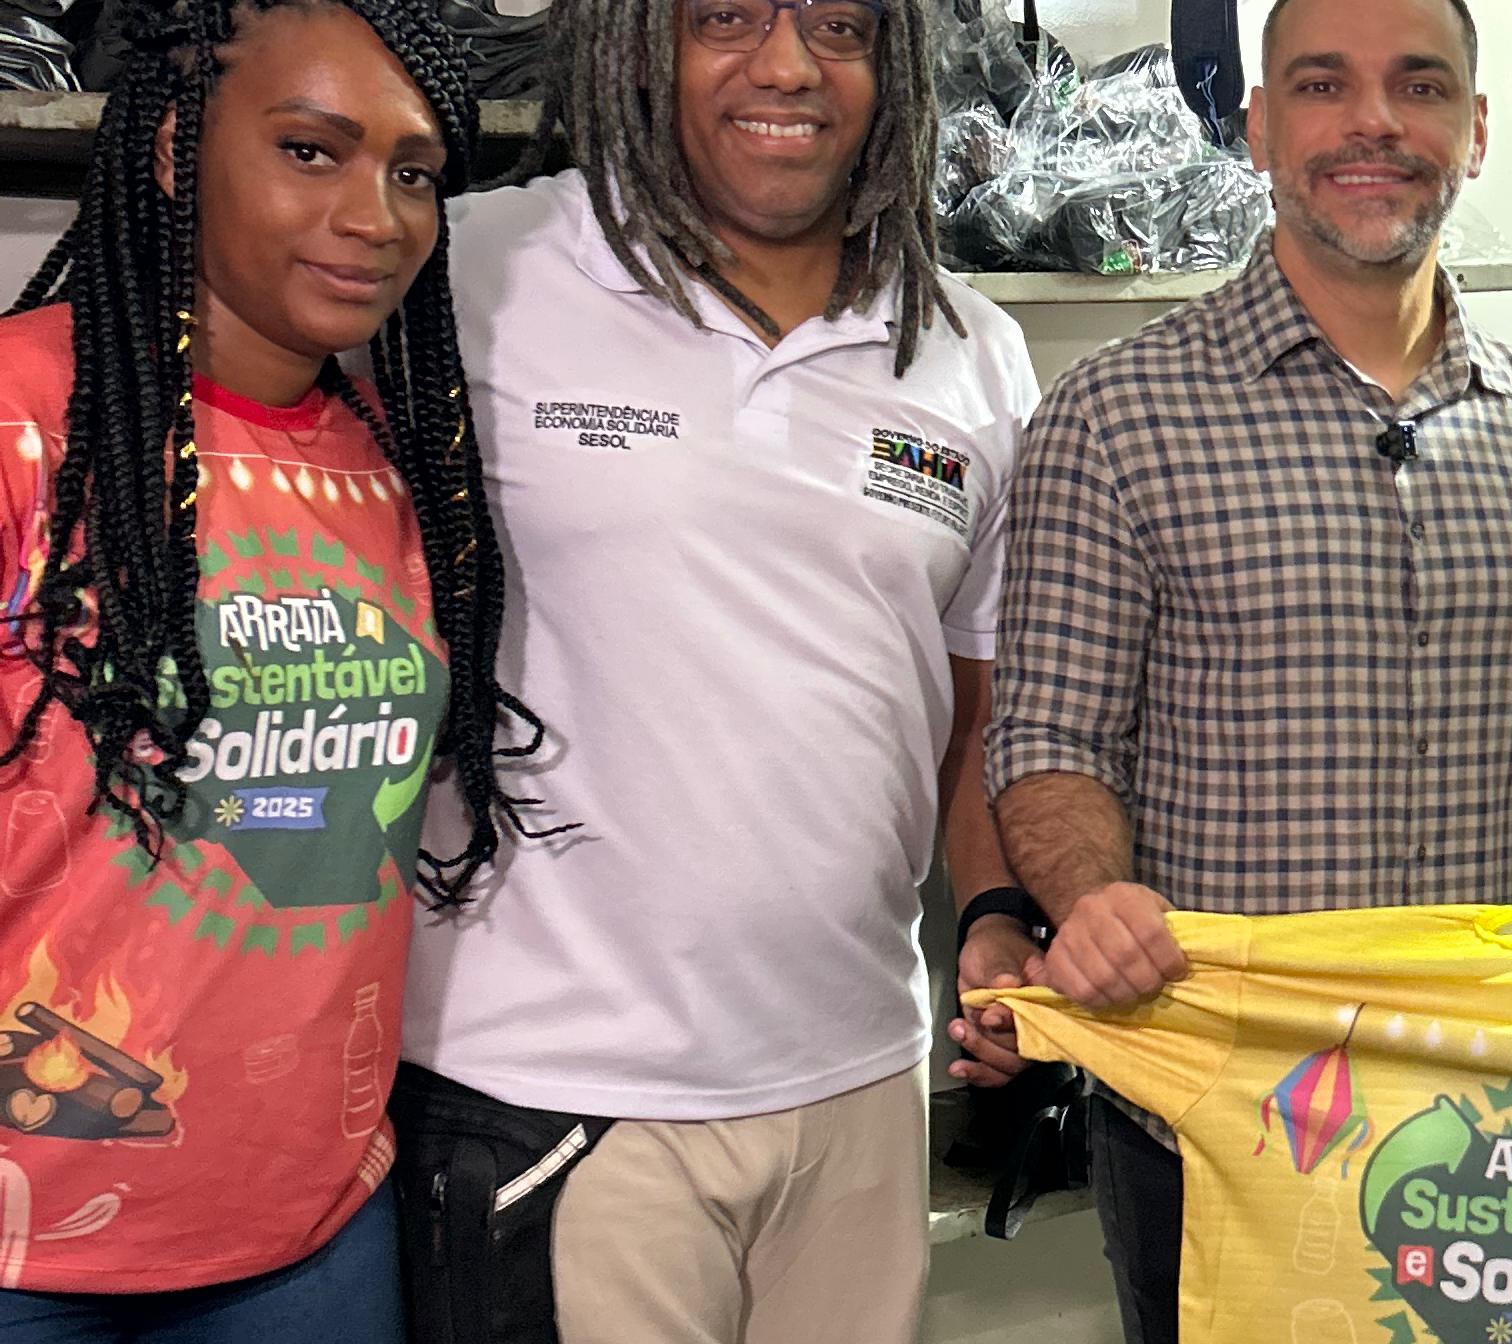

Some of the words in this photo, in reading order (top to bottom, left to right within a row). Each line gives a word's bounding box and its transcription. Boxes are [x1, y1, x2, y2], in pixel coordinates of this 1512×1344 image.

[534, 402, 660, 424] SUPERINTENDÊNCIA
[661, 411, 680, 426] DE
[535, 416, 606, 431] ECONOMIA
[578, 432, 631, 450] SESOL
[219, 587, 346, 652] ARRAIÁ
[155, 643, 427, 708] stentável
[174, 701, 418, 783] Solidário
[251, 796, 313, 819] 2025
[1404, 1249, 1428, 1278] e
